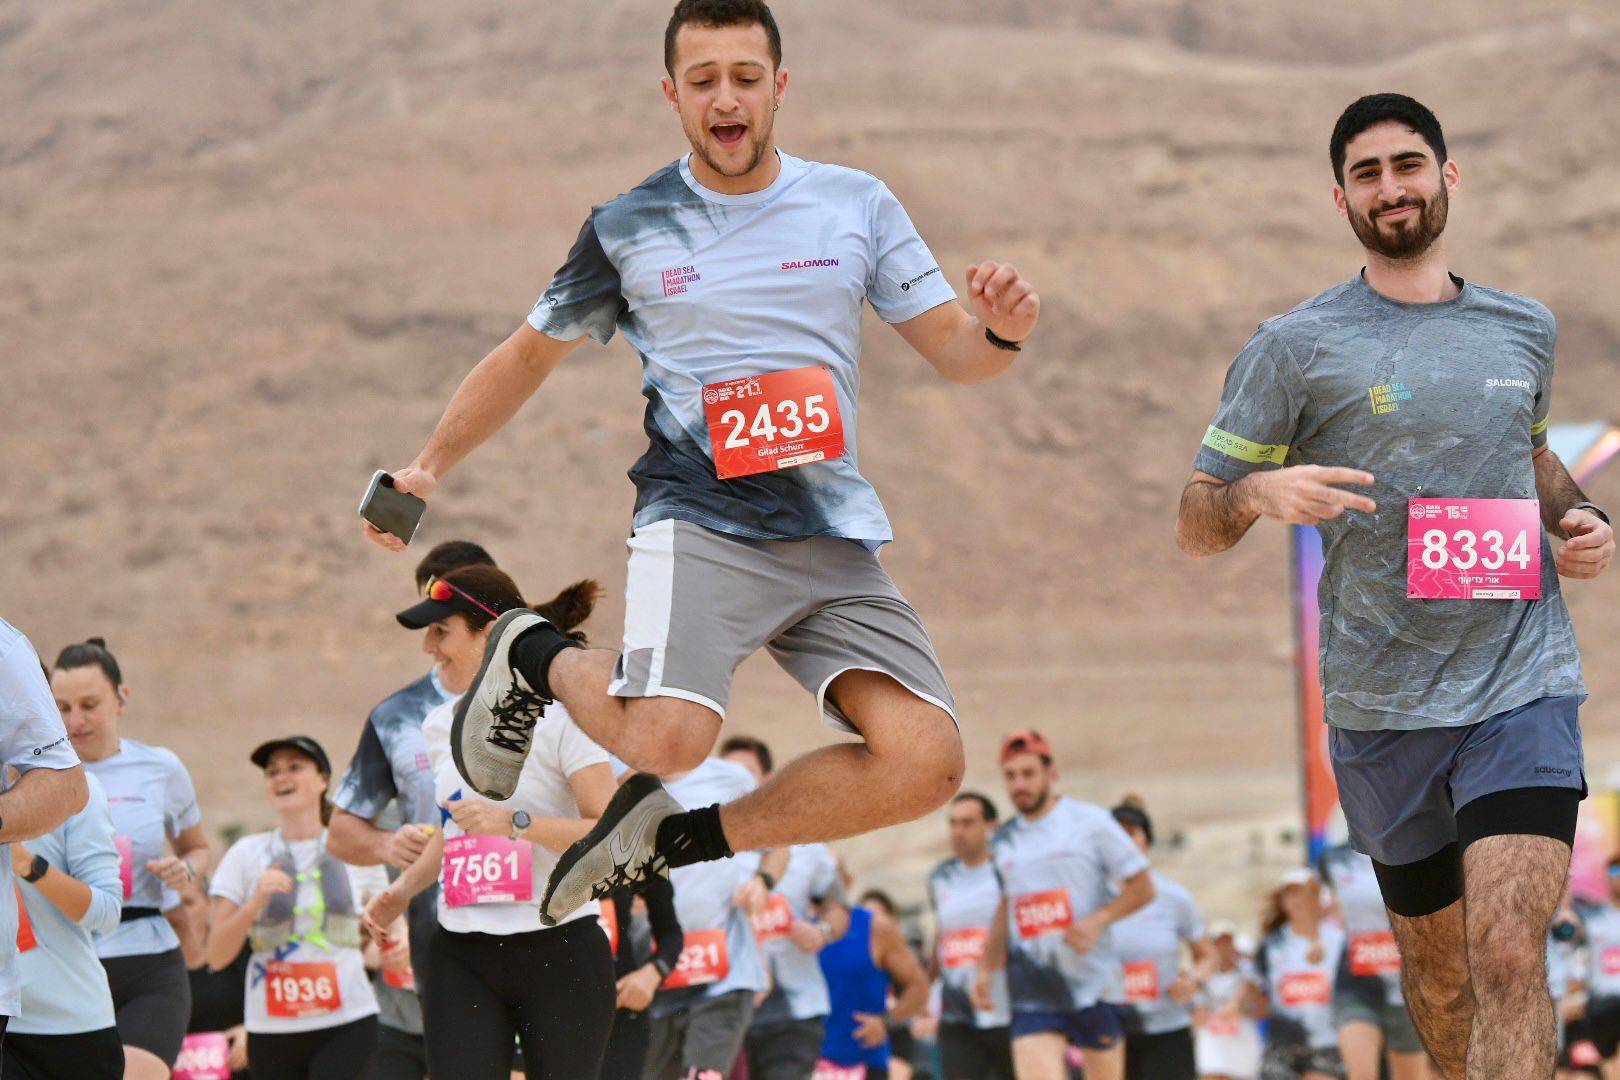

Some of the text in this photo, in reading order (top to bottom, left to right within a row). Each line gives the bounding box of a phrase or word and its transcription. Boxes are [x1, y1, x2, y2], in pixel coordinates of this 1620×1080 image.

[781, 258, 839, 270] SALOMON
[665, 265, 695, 279] DEAD SEA
[666, 272, 701, 287] MARATHON
[667, 284, 689, 297] ISRAEL
[1373, 382, 1405, 395] DEAD SEA
[1485, 378, 1530, 390] SALOMON
[1375, 390, 1413, 405] MARATHON
[1377, 402, 1401, 415] ISRAEL
[720, 394, 830, 450] 2435
[757, 443, 805, 457] Gilad Schurr
[1421, 528, 1531, 570] 8334
[1534, 766, 1572, 777] saucony
[449, 850, 519, 887] 7561
[270, 976, 334, 1003] 1936
